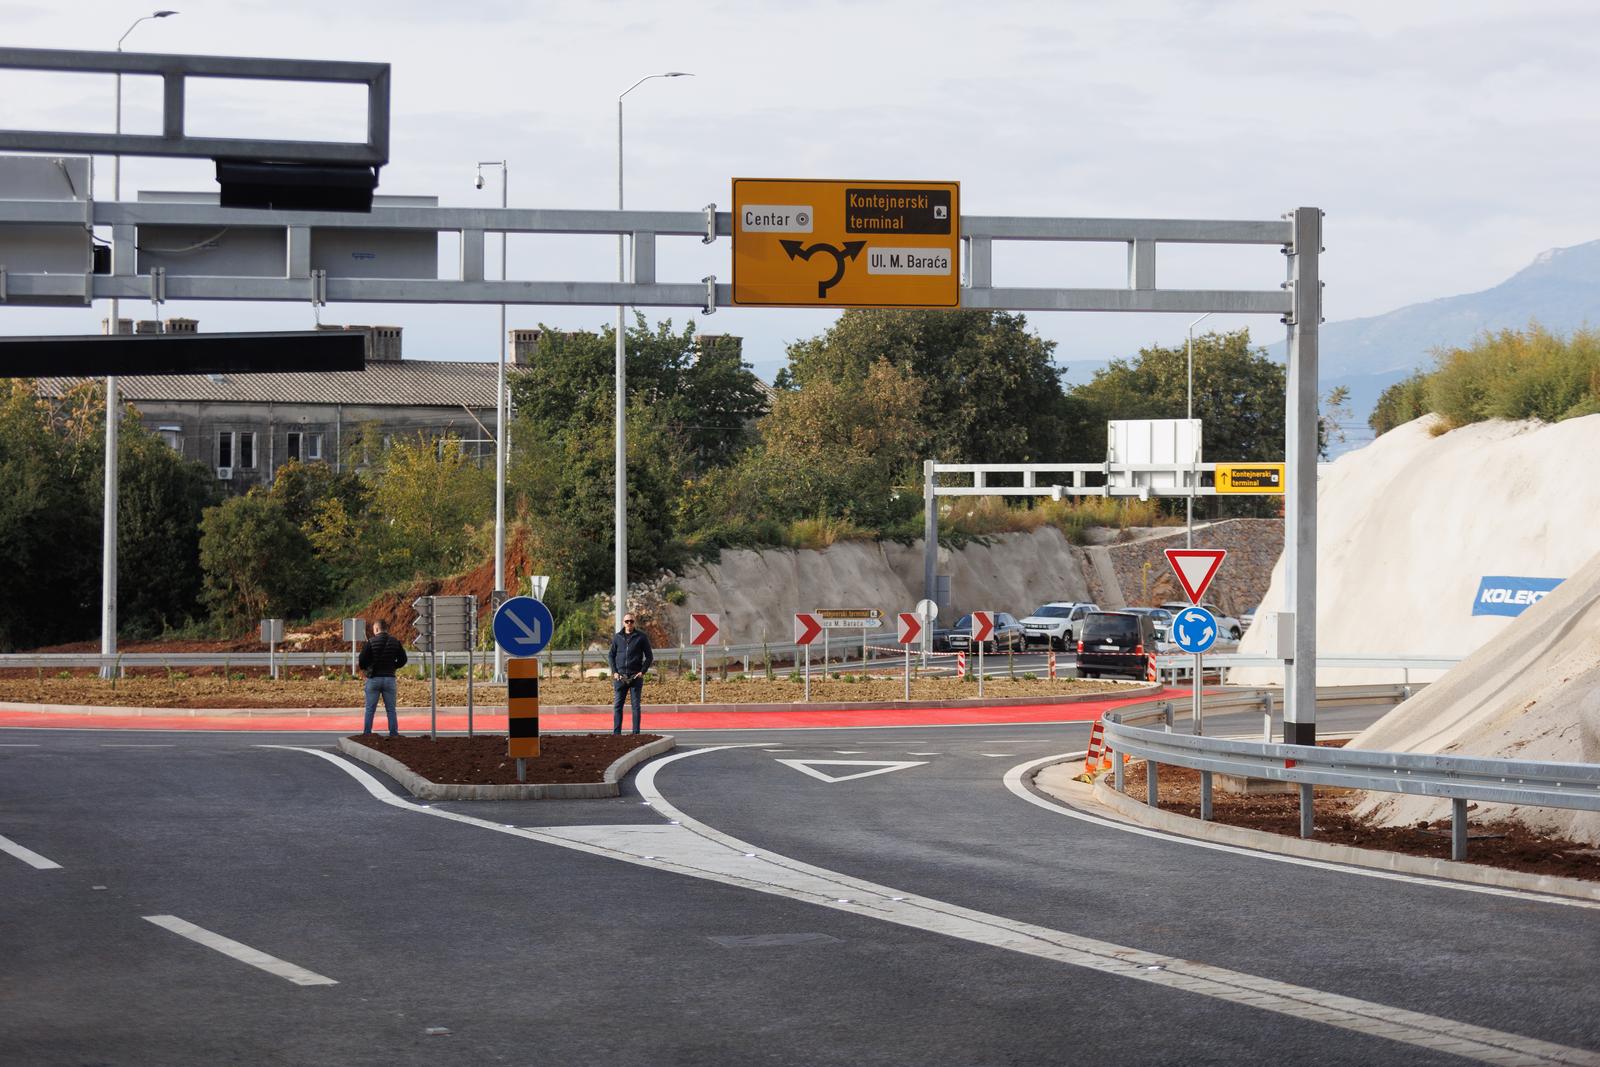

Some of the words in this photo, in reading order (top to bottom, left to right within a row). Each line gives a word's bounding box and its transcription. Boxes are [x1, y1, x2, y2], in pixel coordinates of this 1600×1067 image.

[850, 194, 928, 212] Kontejnerski
[745, 211, 790, 227] Centar
[850, 215, 904, 229] terminal
[871, 254, 886, 268] Ul.
[890, 254, 904, 268] M.
[907, 254, 948, 269] Baraća
[1232, 470, 1271, 479] Kontejnerski
